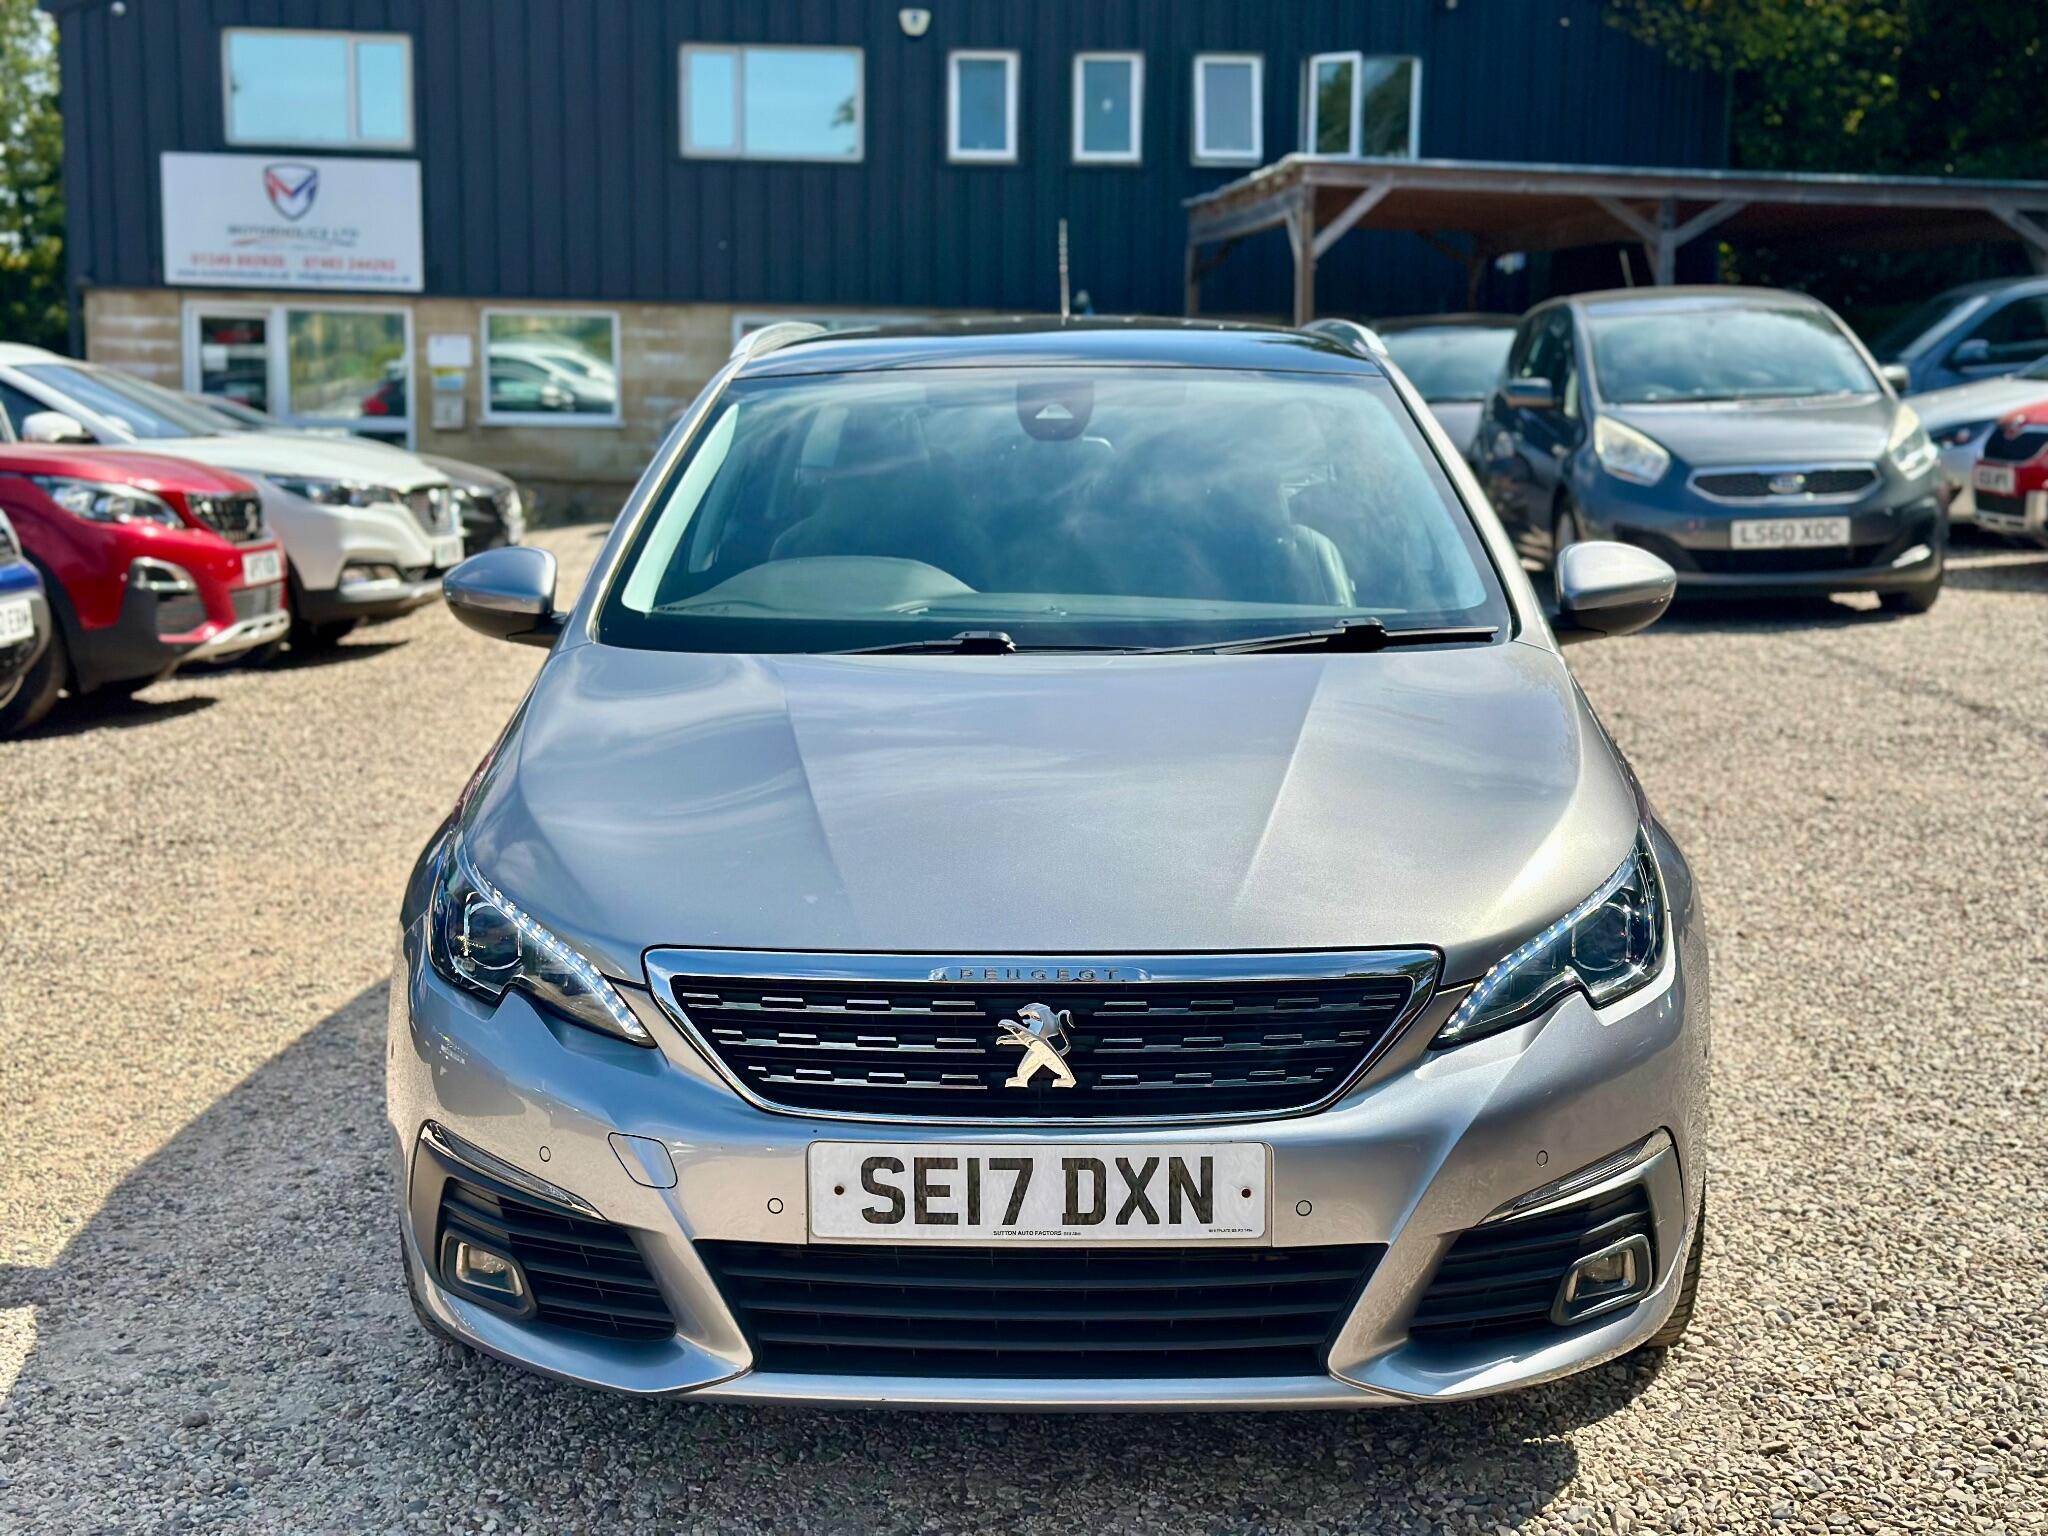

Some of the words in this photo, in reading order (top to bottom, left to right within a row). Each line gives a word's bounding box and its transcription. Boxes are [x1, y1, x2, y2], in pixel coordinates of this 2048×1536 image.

[959, 968, 1119, 981] PEUGEOT
[861, 1156, 1033, 1226] SE17
[1062, 1156, 1214, 1226] DXN
